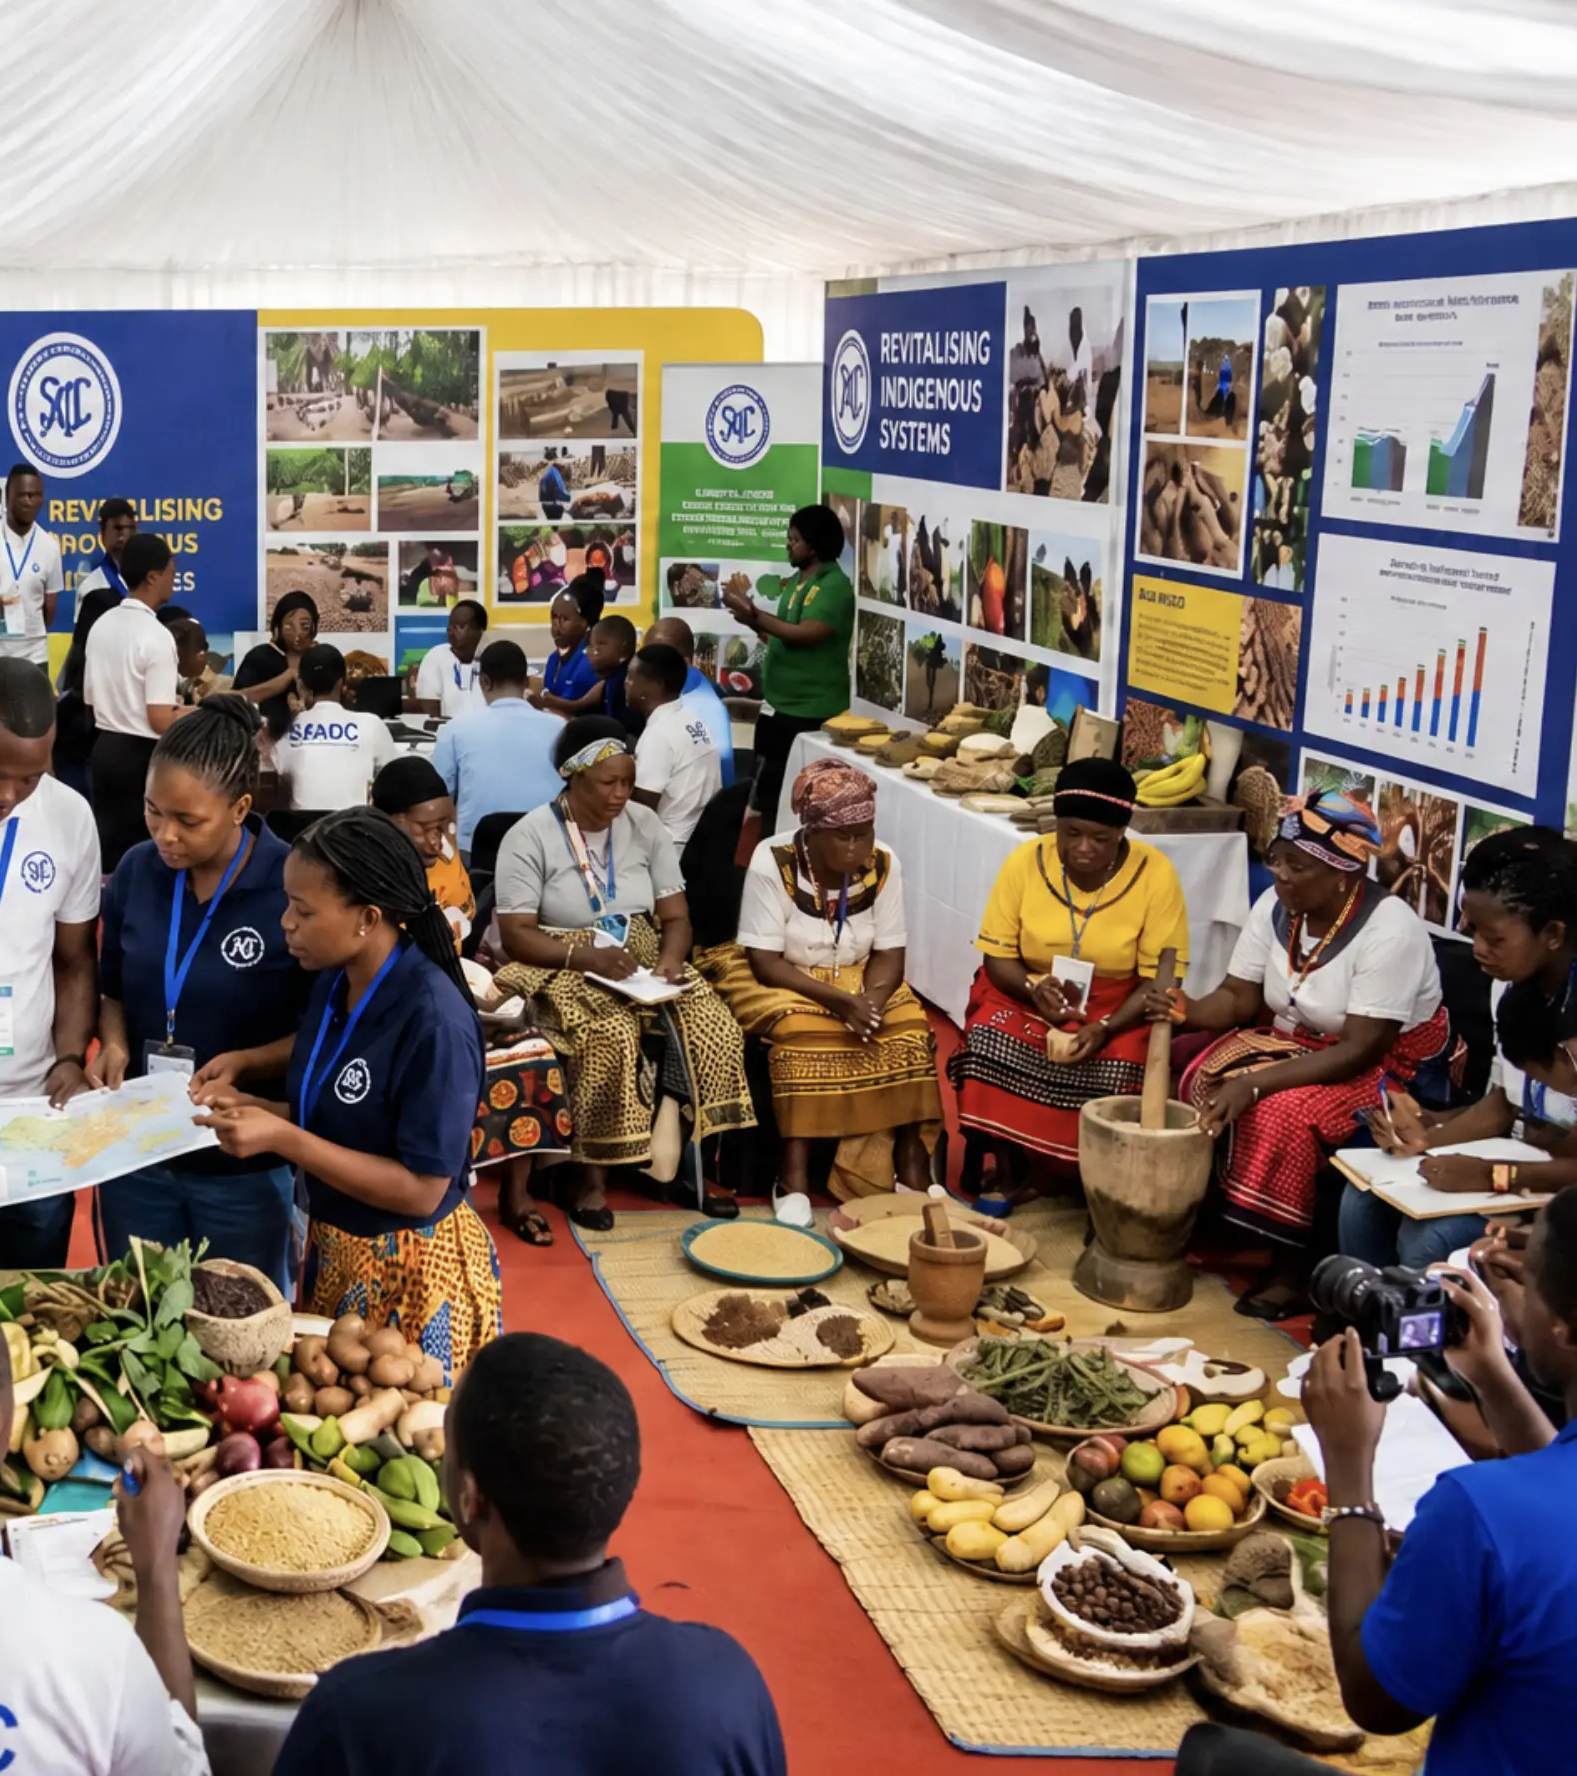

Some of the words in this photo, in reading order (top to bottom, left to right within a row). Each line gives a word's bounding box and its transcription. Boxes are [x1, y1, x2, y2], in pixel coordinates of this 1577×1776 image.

[881, 331, 991, 365] REVITALISING
[881, 376, 983, 413] INDIGENOUS
[880, 418, 950, 455] SYSTEMS
